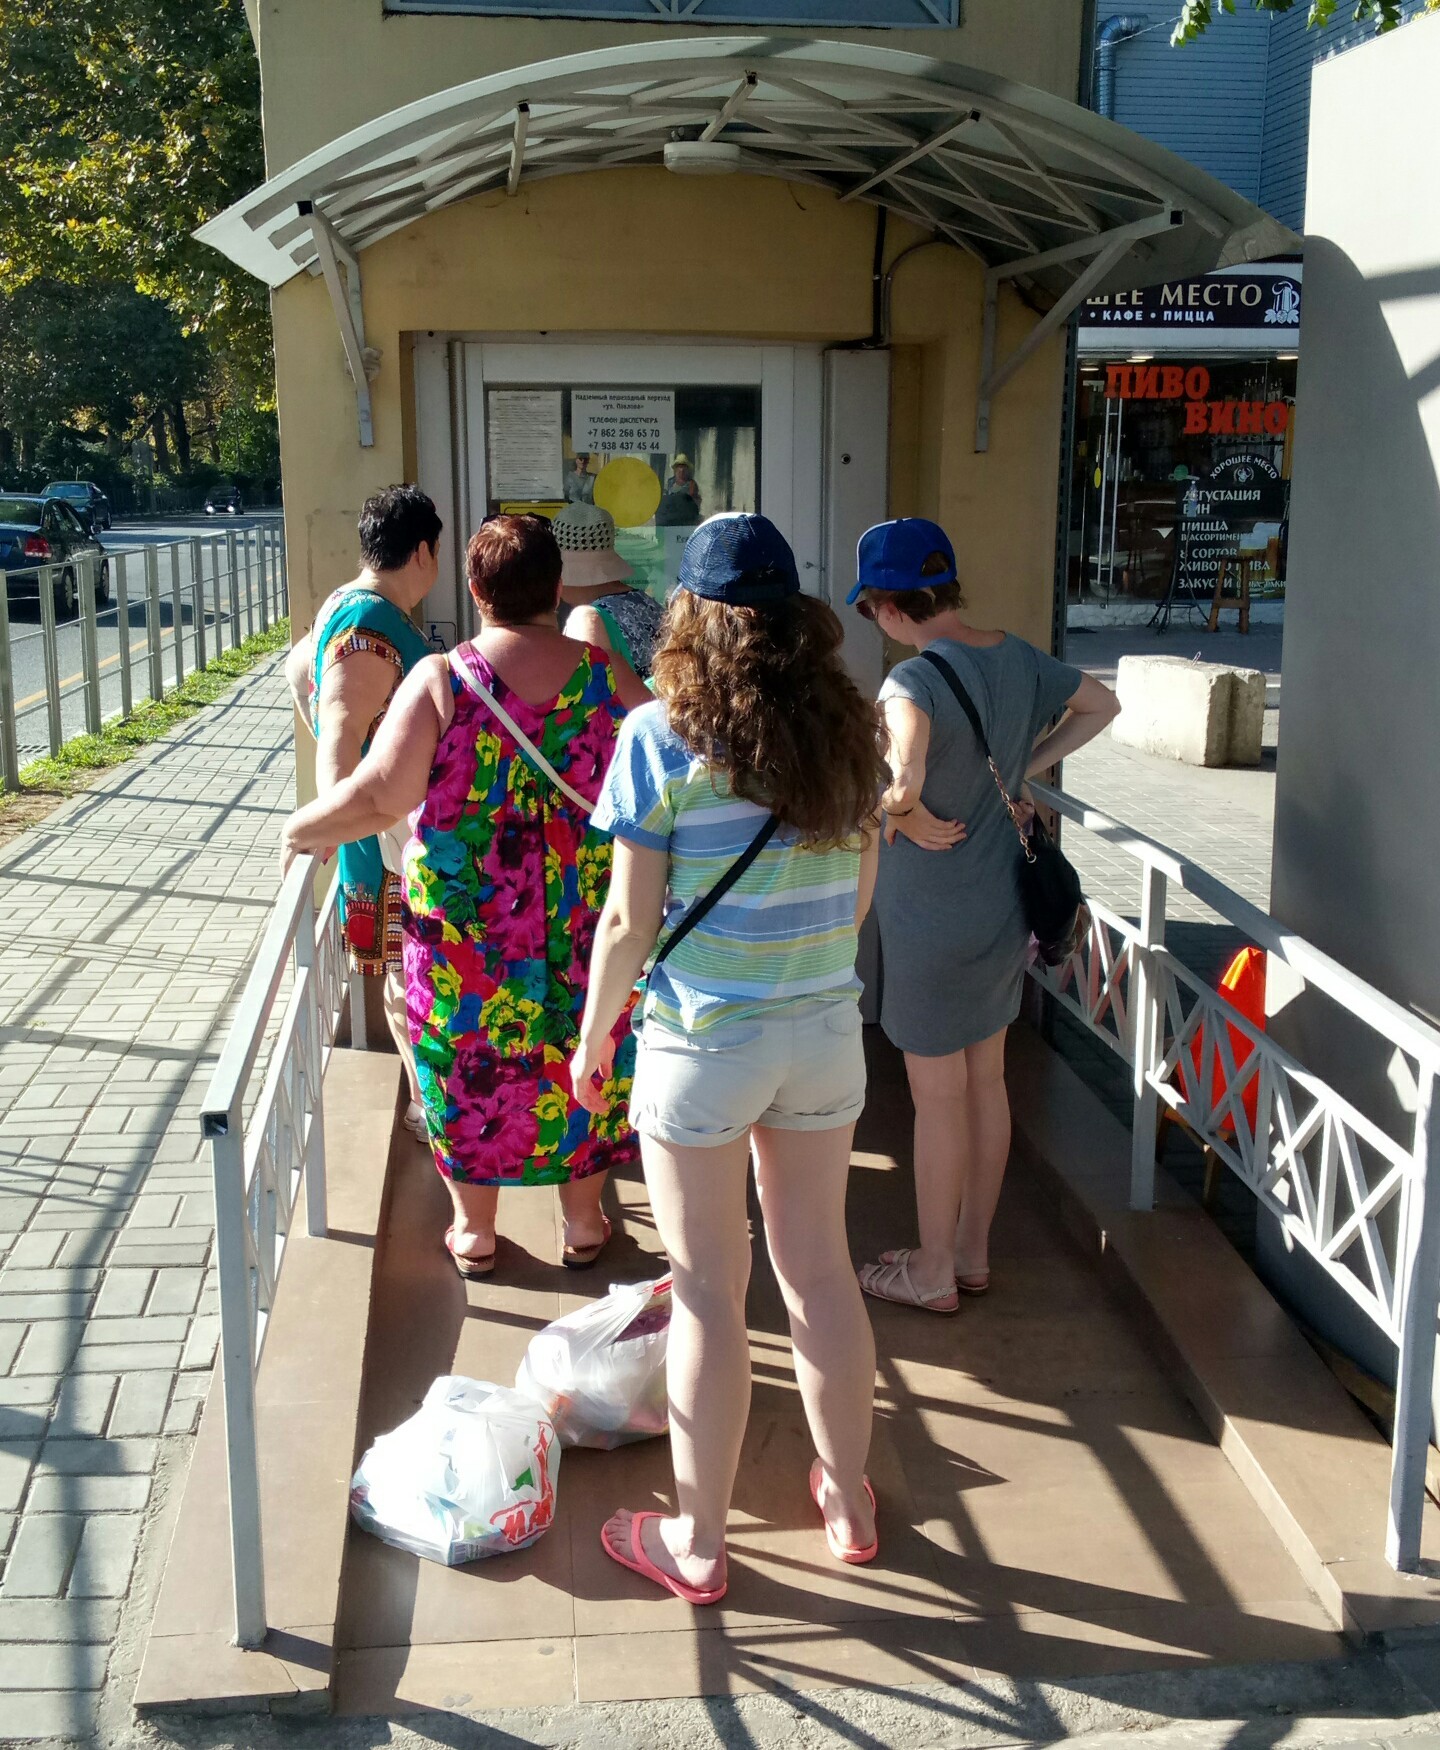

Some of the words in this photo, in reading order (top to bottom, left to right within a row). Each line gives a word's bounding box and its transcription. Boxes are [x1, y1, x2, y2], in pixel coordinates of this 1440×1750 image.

[1160, 284, 1263, 306] МЕСТО
[1103, 310, 1143, 321] КАФЕ
[1163, 310, 1215, 323] ПИЦЦА
[1104, 365, 1211, 400] ПИВО
[588, 416, 618, 424] ТЕЛЕФОН
[1183, 401, 1289, 435] ВИНО
[588, 429, 598, 437] +7
[601, 428, 616, 437] 862
[619, 429, 634, 437] 268
[637, 429, 647, 437] 65
[650, 428, 660, 437] 70
[588, 442, 598, 450] +7
[601, 441, 617, 450] 938
[619, 442, 634, 450] 437
[637, 442, 647, 450] 45
[649, 442, 660, 450] 44
[1210, 455, 1252, 480] ХОРОШЕЕ
[1253, 457, 1278, 479] МЕСТО
[1178, 578, 1233, 590] ЗАКУСИ
